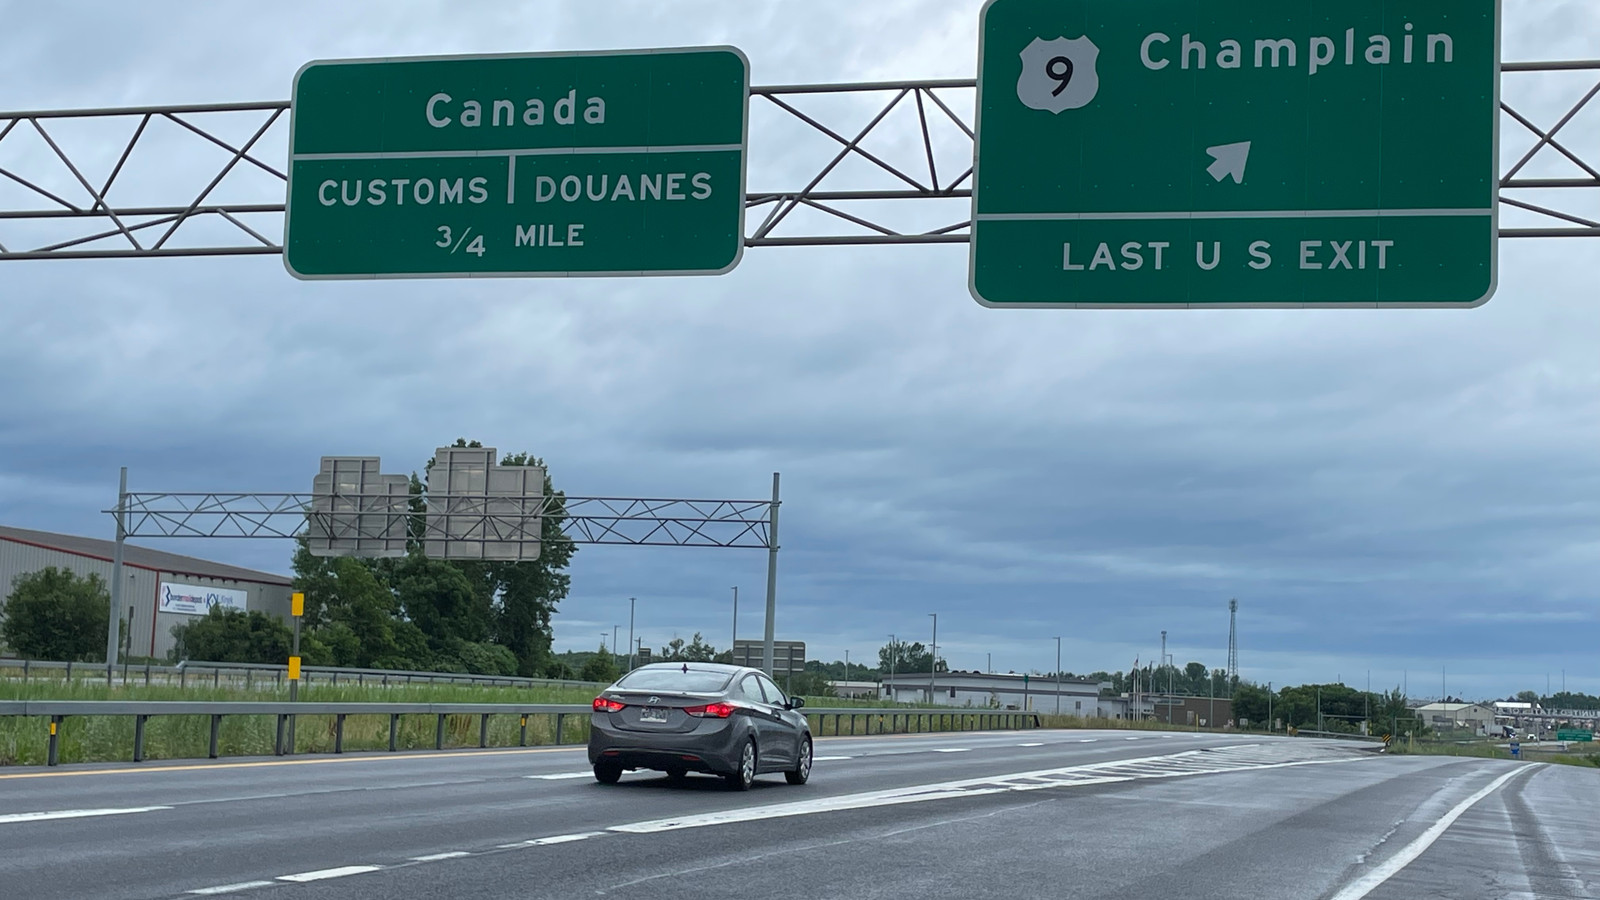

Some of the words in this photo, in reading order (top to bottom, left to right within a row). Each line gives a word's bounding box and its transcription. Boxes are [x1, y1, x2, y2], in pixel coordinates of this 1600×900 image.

[1139, 22, 1453, 75] Champlain
[1045, 56, 1074, 97] 9
[426, 89, 606, 128] Canada
[318, 177, 488, 206] CUSTOMS
[535, 172, 713, 203] DOUANES
[435, 225, 486, 257] 3/4
[514, 223, 584, 247] MILE
[1062, 241, 1170, 271] LAST
[1196, 241, 1221, 271] U
[1247, 240, 1272, 270] S
[1299, 240, 1394, 270] EXIT
